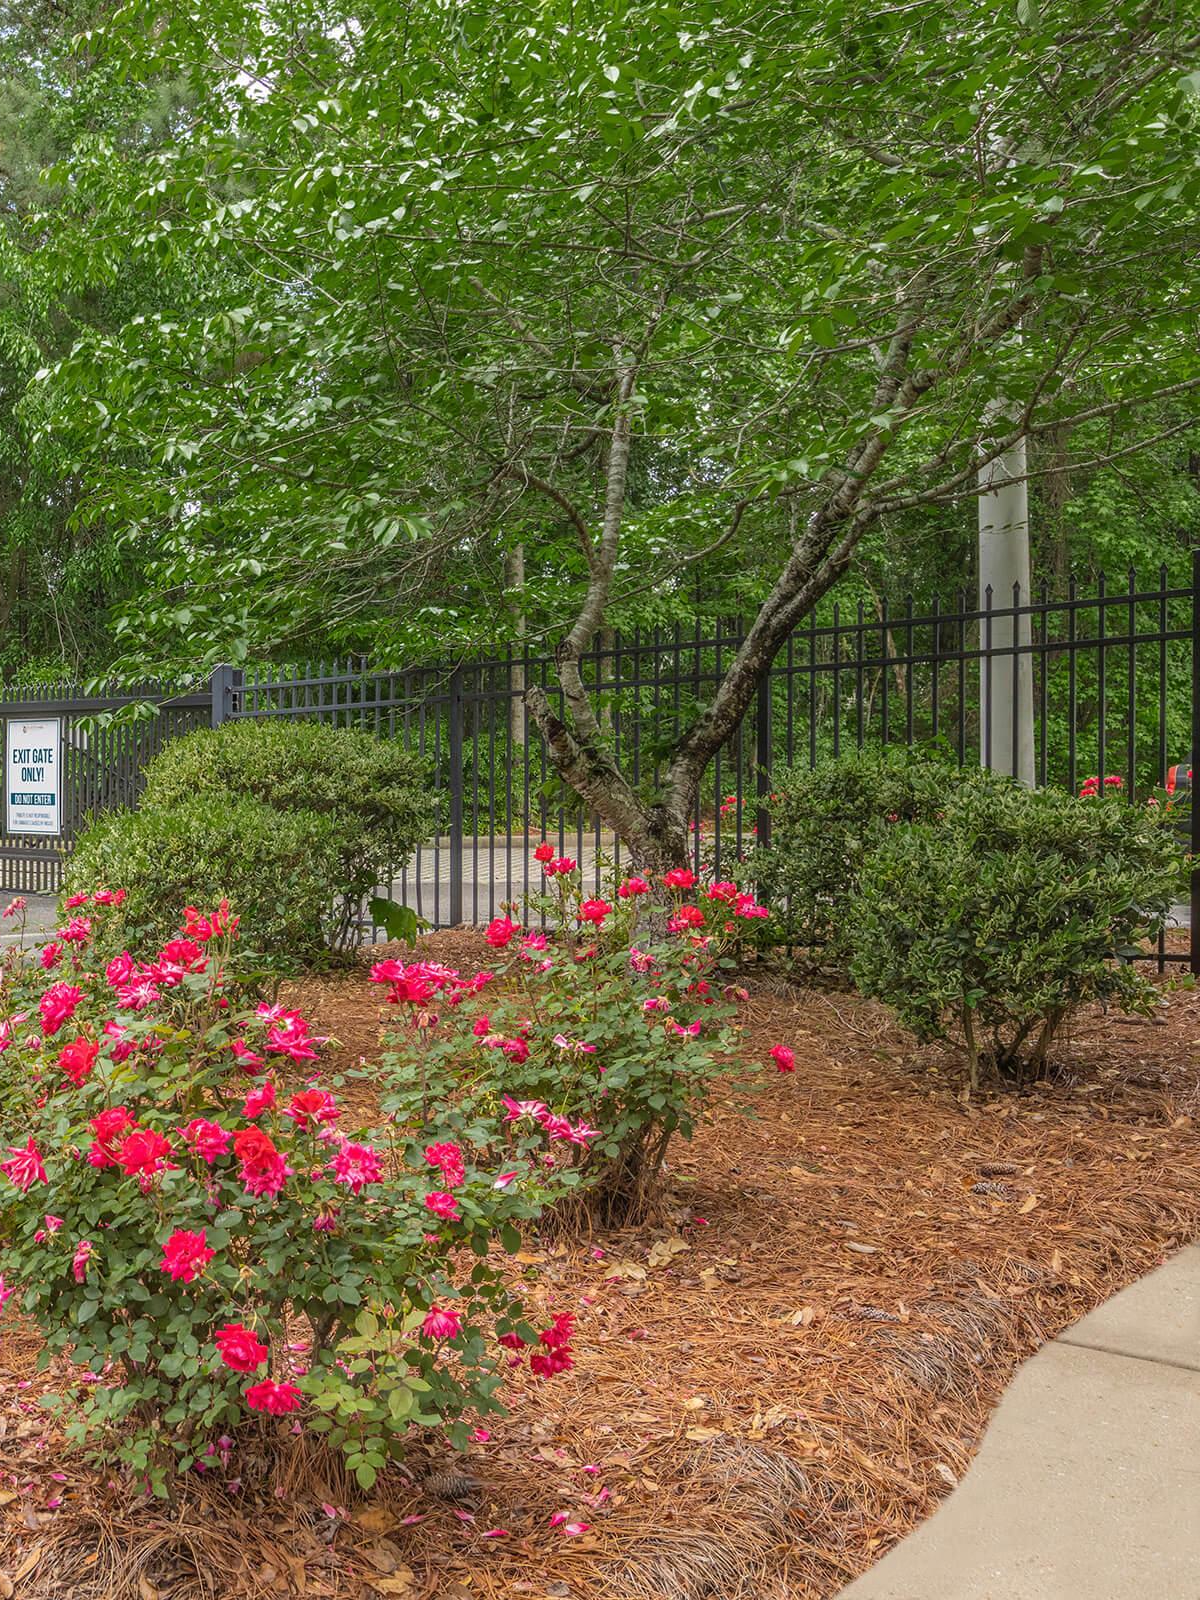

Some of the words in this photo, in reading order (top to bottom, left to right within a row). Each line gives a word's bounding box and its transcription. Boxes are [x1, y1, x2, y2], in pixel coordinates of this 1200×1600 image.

[13, 748, 31, 763] EXIT
[32, 748, 53, 763] GATE
[21, 767, 44, 782] ONLY!
[15, 794, 22, 804] DO
[23, 794, 33, 804] NOT
[34, 795, 51, 805] ENTER
